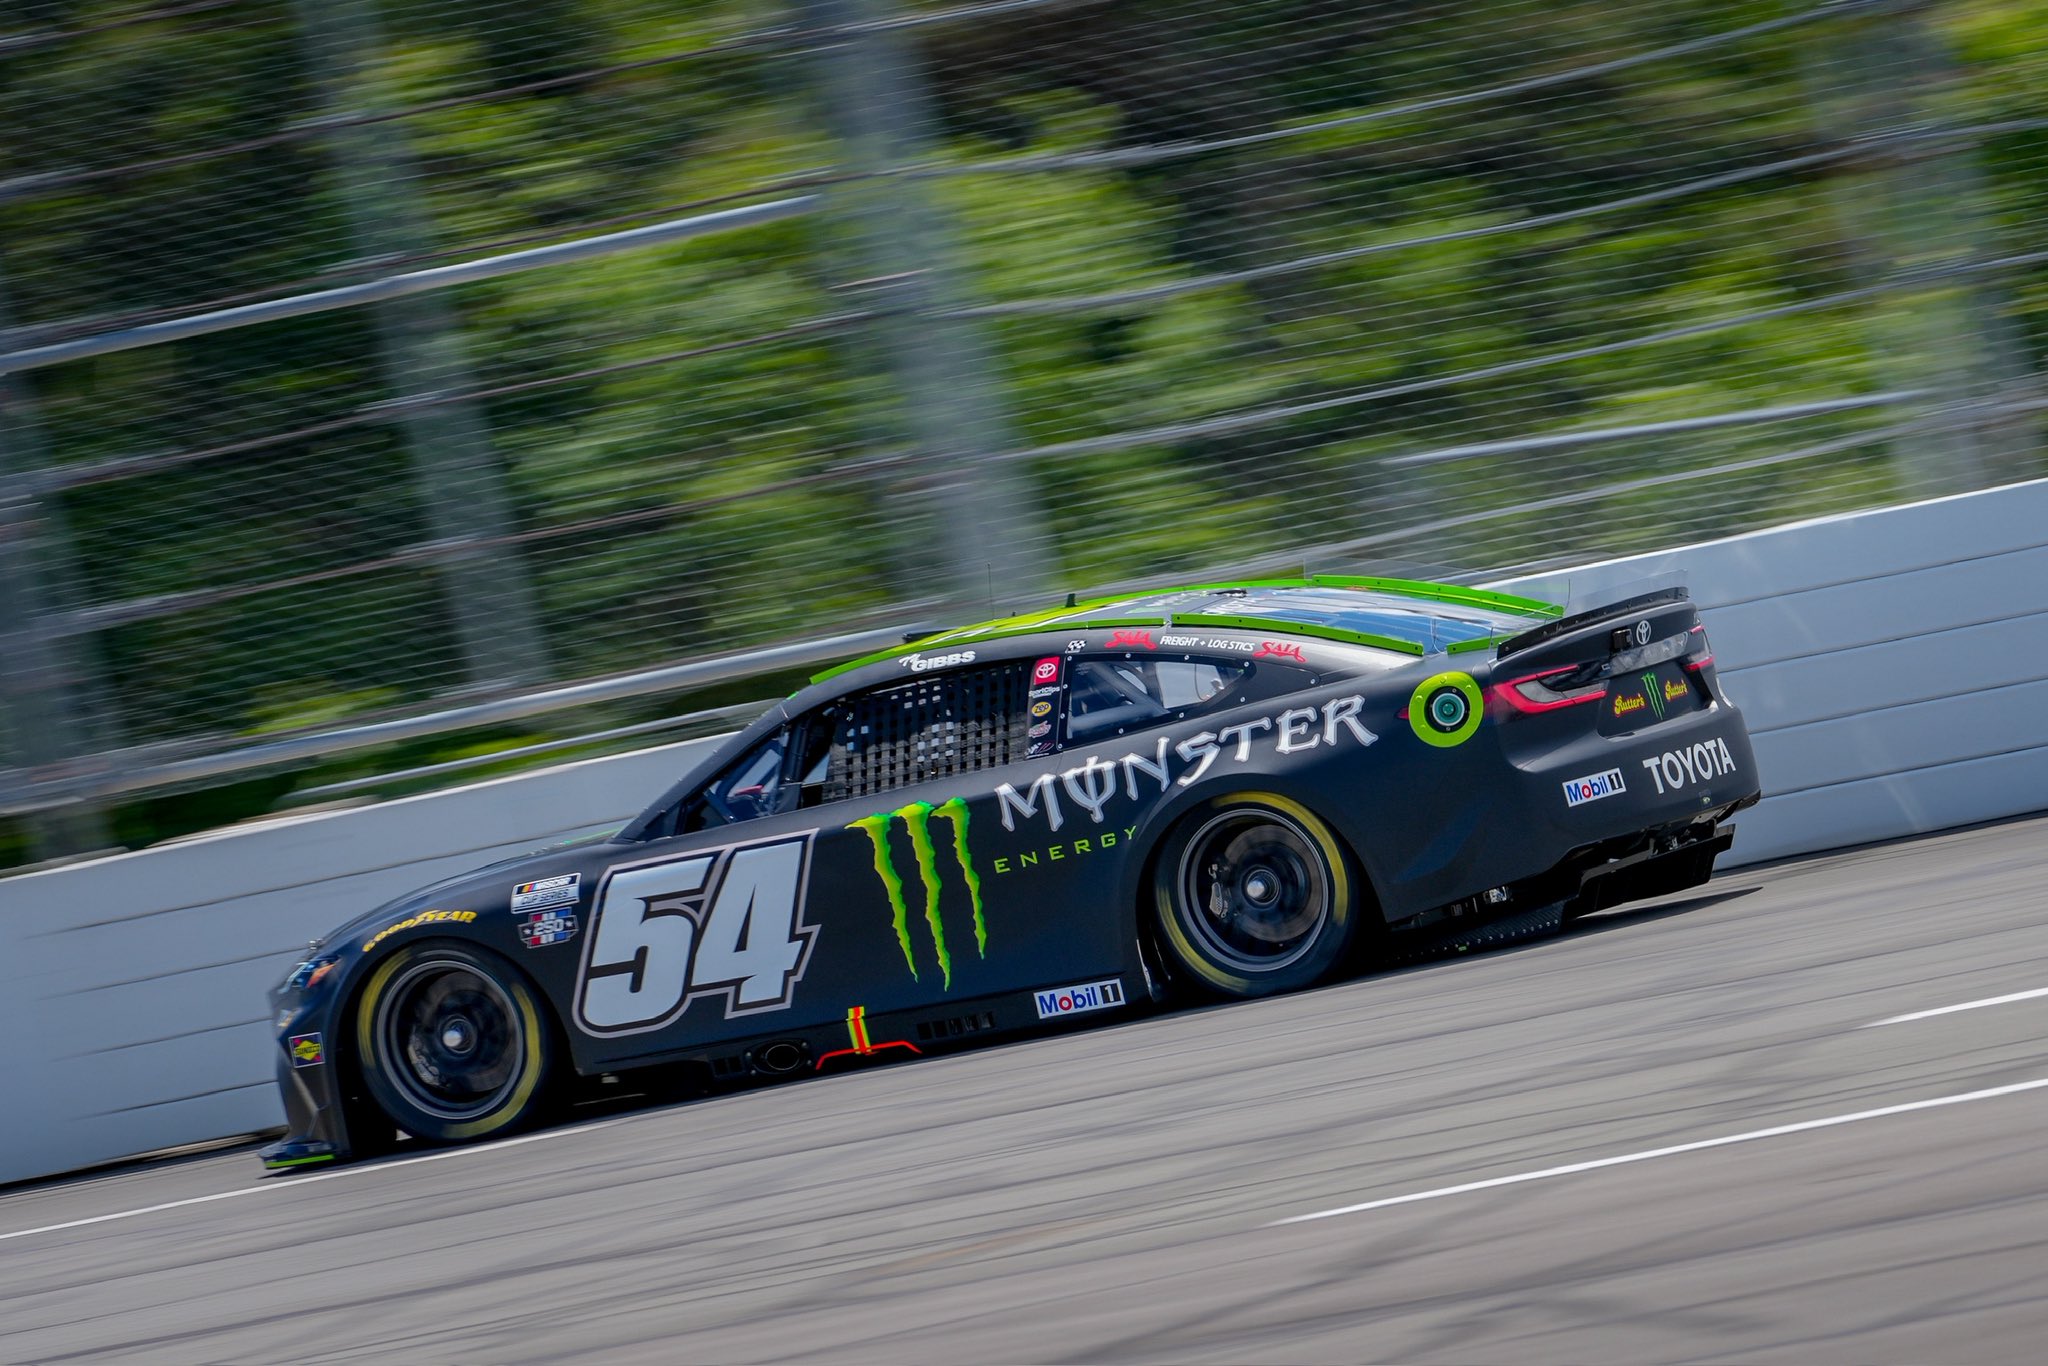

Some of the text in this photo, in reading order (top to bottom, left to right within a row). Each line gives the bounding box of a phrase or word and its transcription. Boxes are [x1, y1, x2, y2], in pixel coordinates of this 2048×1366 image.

[1160, 635, 1199, 647] FREIGHT
[1207, 638, 1255, 652] LOGSTICS
[1252, 641, 1306, 663] SAIA
[911, 650, 976, 672] GIBBS
[994, 694, 1379, 832] MONSTER
[1642, 737, 1737, 794] TOYOTA
[1566, 774, 1620, 804] Mobil 1
[994, 825, 1137, 874] ENERGY
[362, 909, 478, 953] GOODYEAR
[532, 918, 565, 936] 250
[572, 828, 822, 1038] 54
[1038, 985, 1115, 1015] Mobil 1
